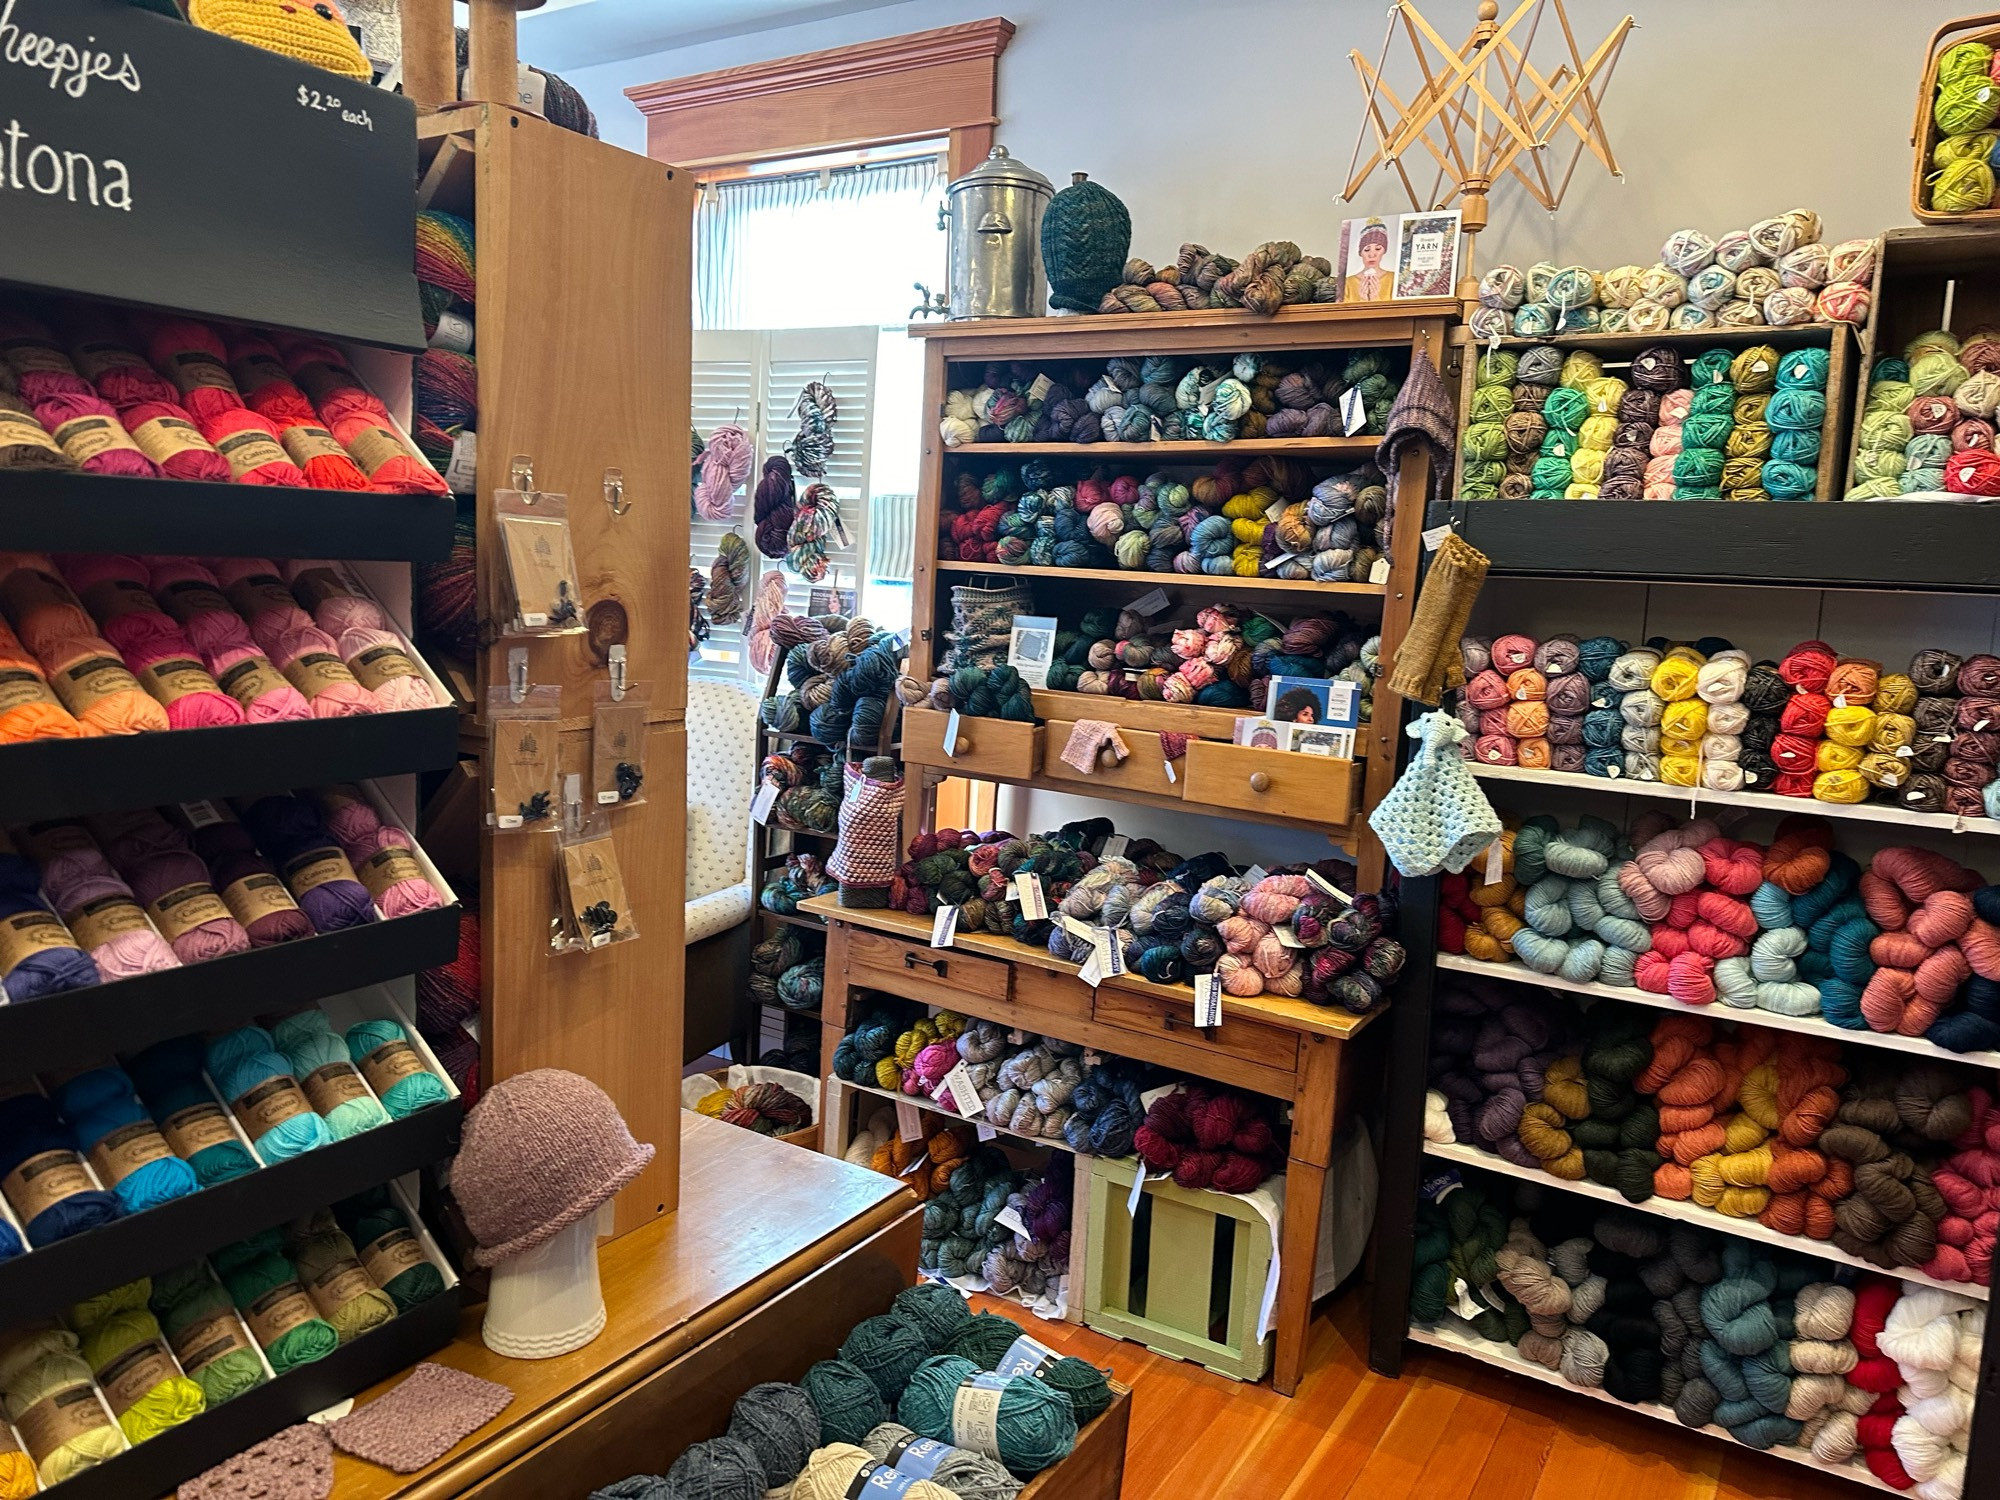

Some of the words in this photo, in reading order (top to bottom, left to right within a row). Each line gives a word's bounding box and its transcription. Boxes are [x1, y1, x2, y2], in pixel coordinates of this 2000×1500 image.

[341, 109, 374, 132] each
[0, 119, 133, 211] tona
[265, 1099, 296, 1116] Catona
[953, 1071, 977, 1112] WASHTED
